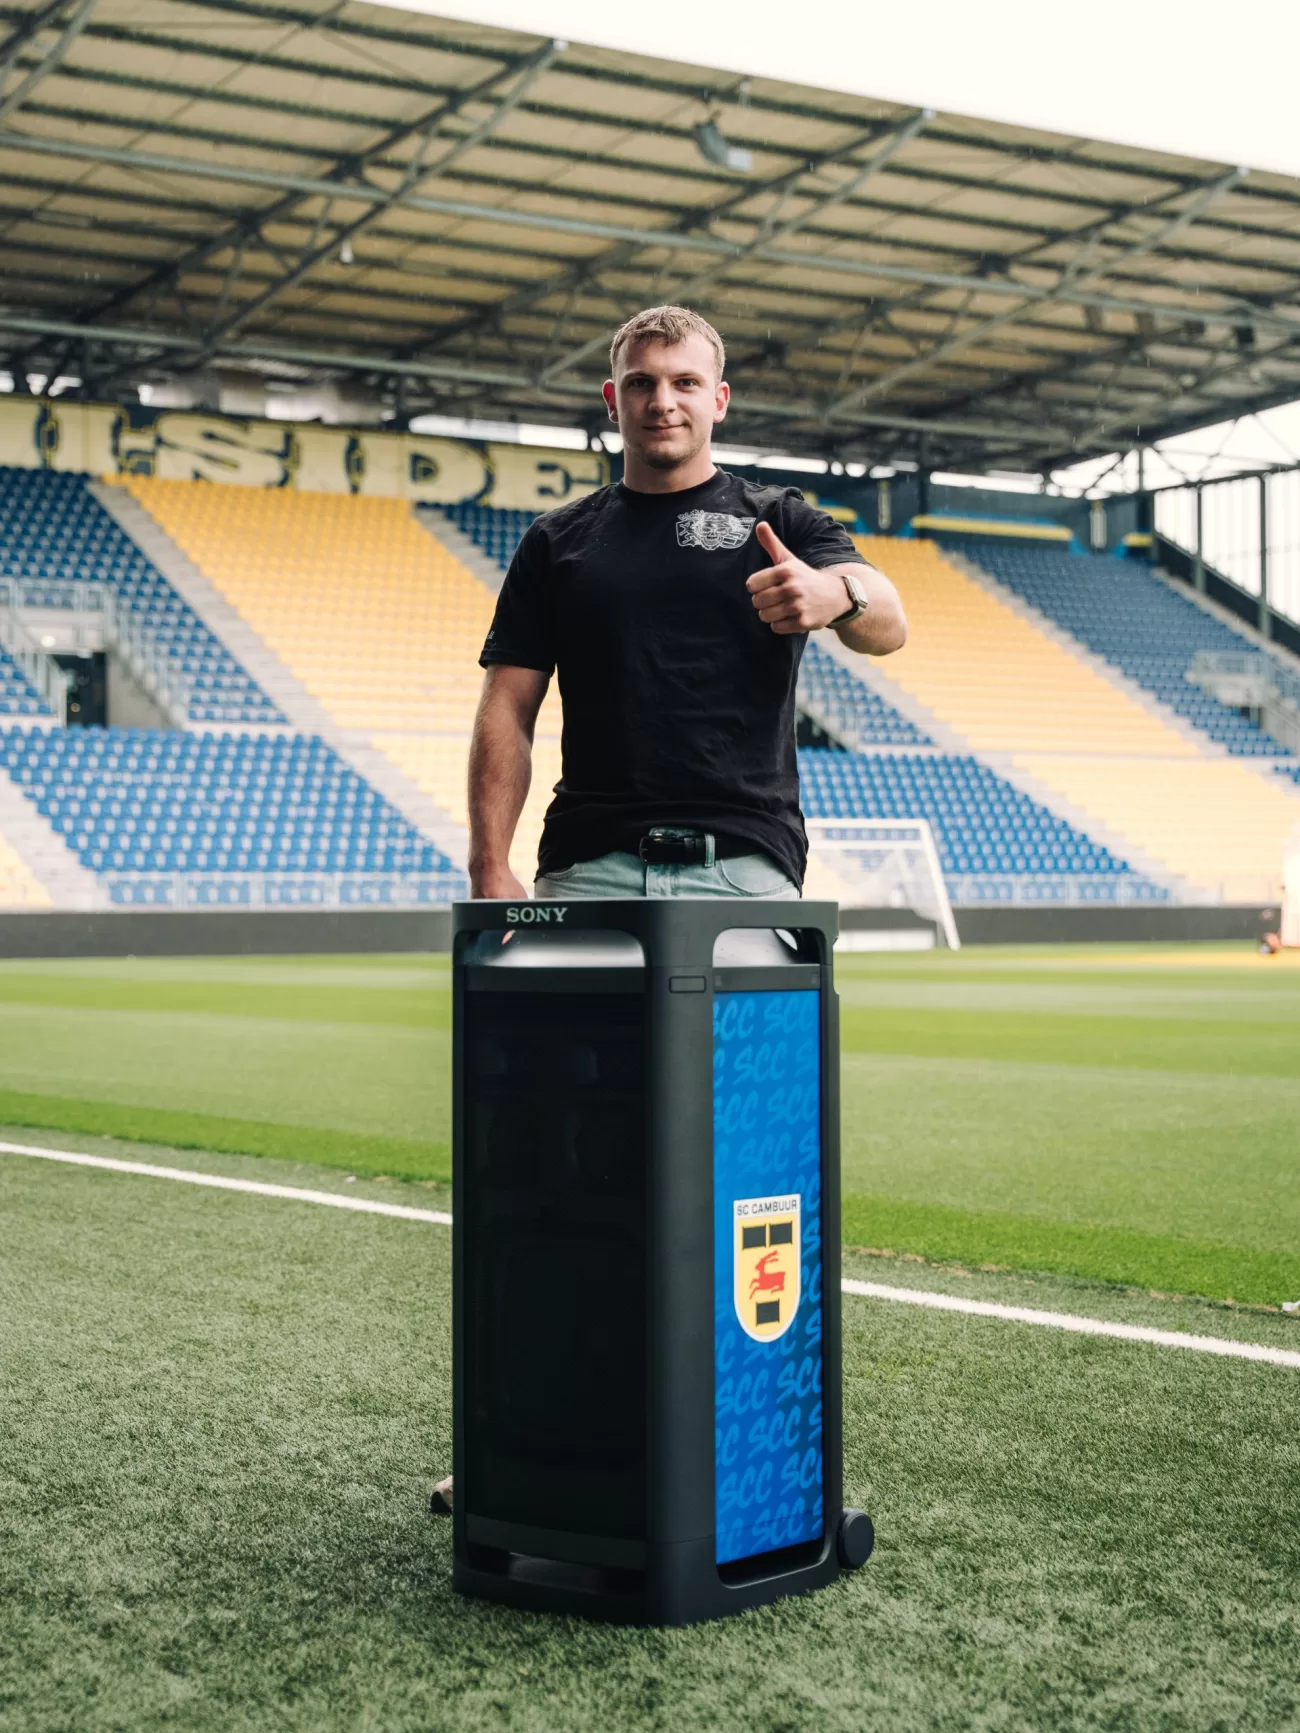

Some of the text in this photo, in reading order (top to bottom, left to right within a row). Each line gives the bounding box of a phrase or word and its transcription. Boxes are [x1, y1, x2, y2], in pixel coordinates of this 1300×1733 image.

[506, 907, 568, 923] SONY
[737, 1199, 797, 1216] SC CAMBUUR
